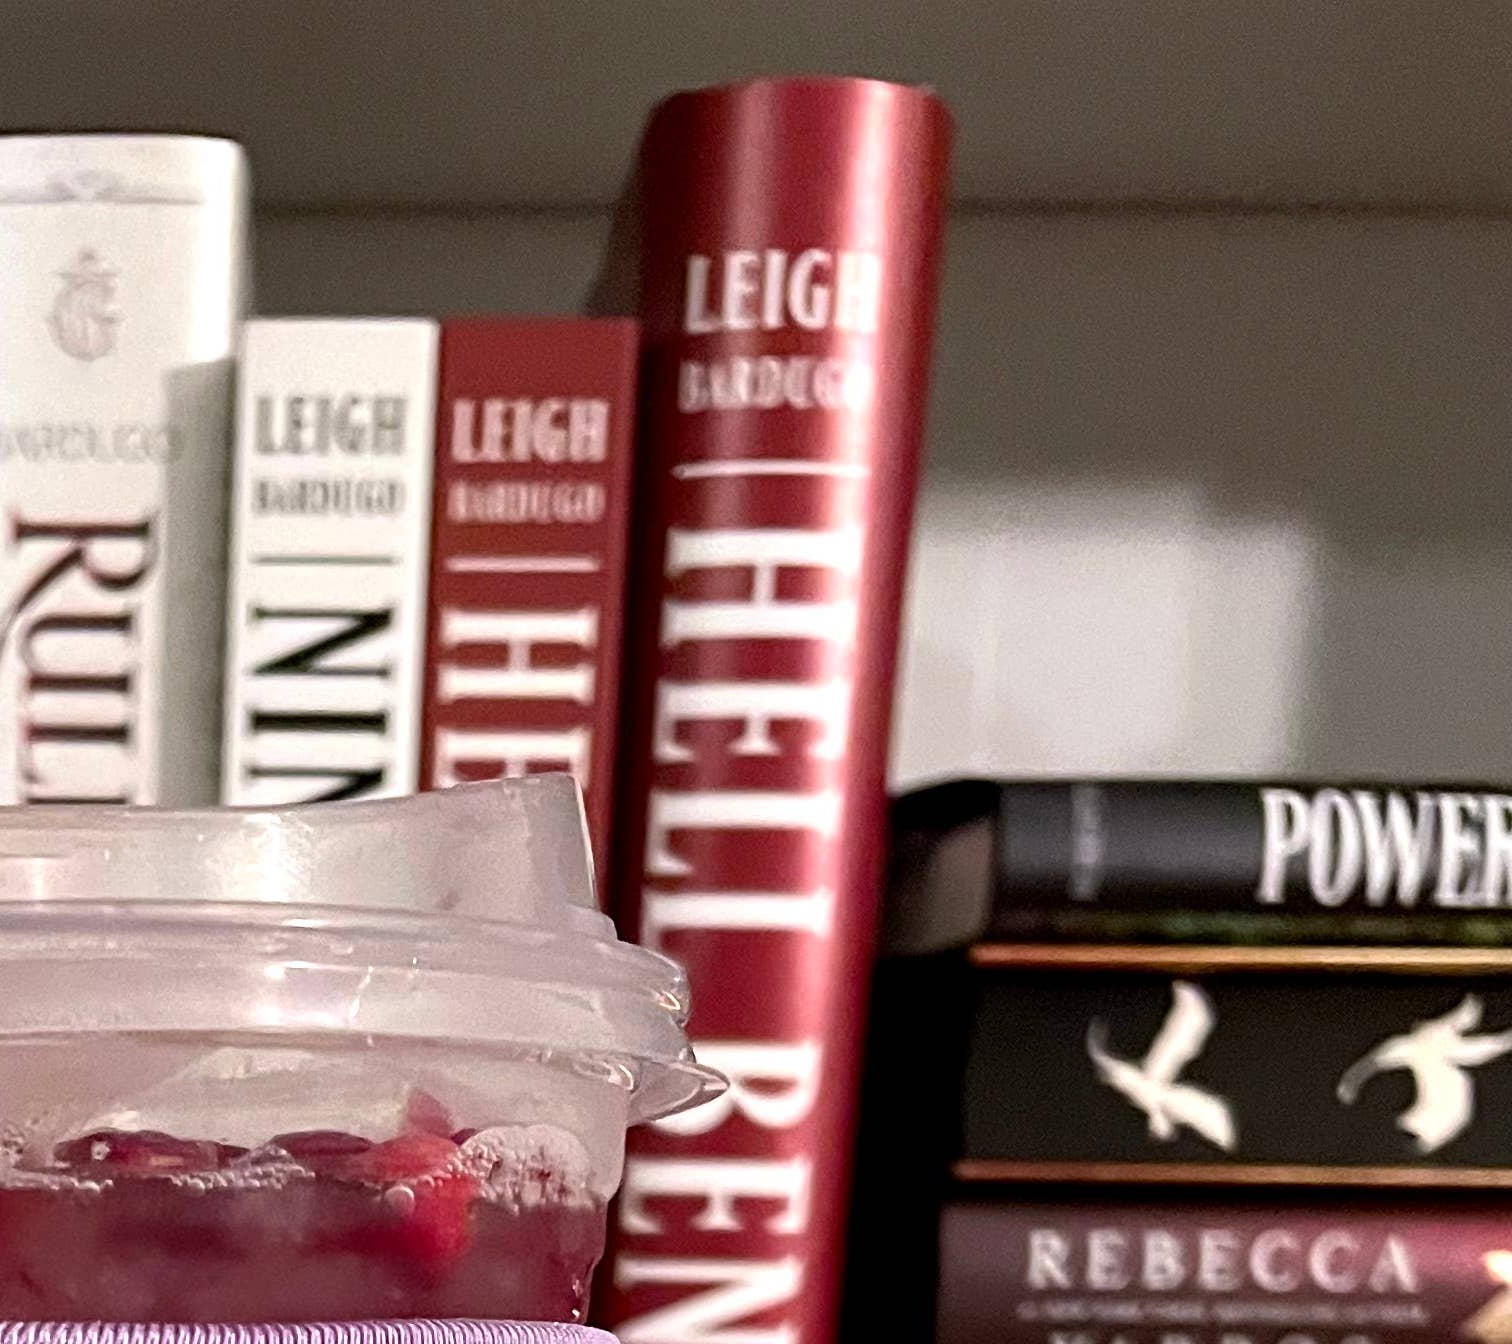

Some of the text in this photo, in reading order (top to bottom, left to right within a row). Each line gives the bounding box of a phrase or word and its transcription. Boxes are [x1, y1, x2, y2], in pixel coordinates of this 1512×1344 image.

[685, 248, 882, 333] LEIGH
[678, 354, 876, 413] BARDUGO
[252, 397, 408, 457] LEIGH
[450, 397, 610, 464] LEIGH
[1025, 1226, 1421, 1293] REBECCA
